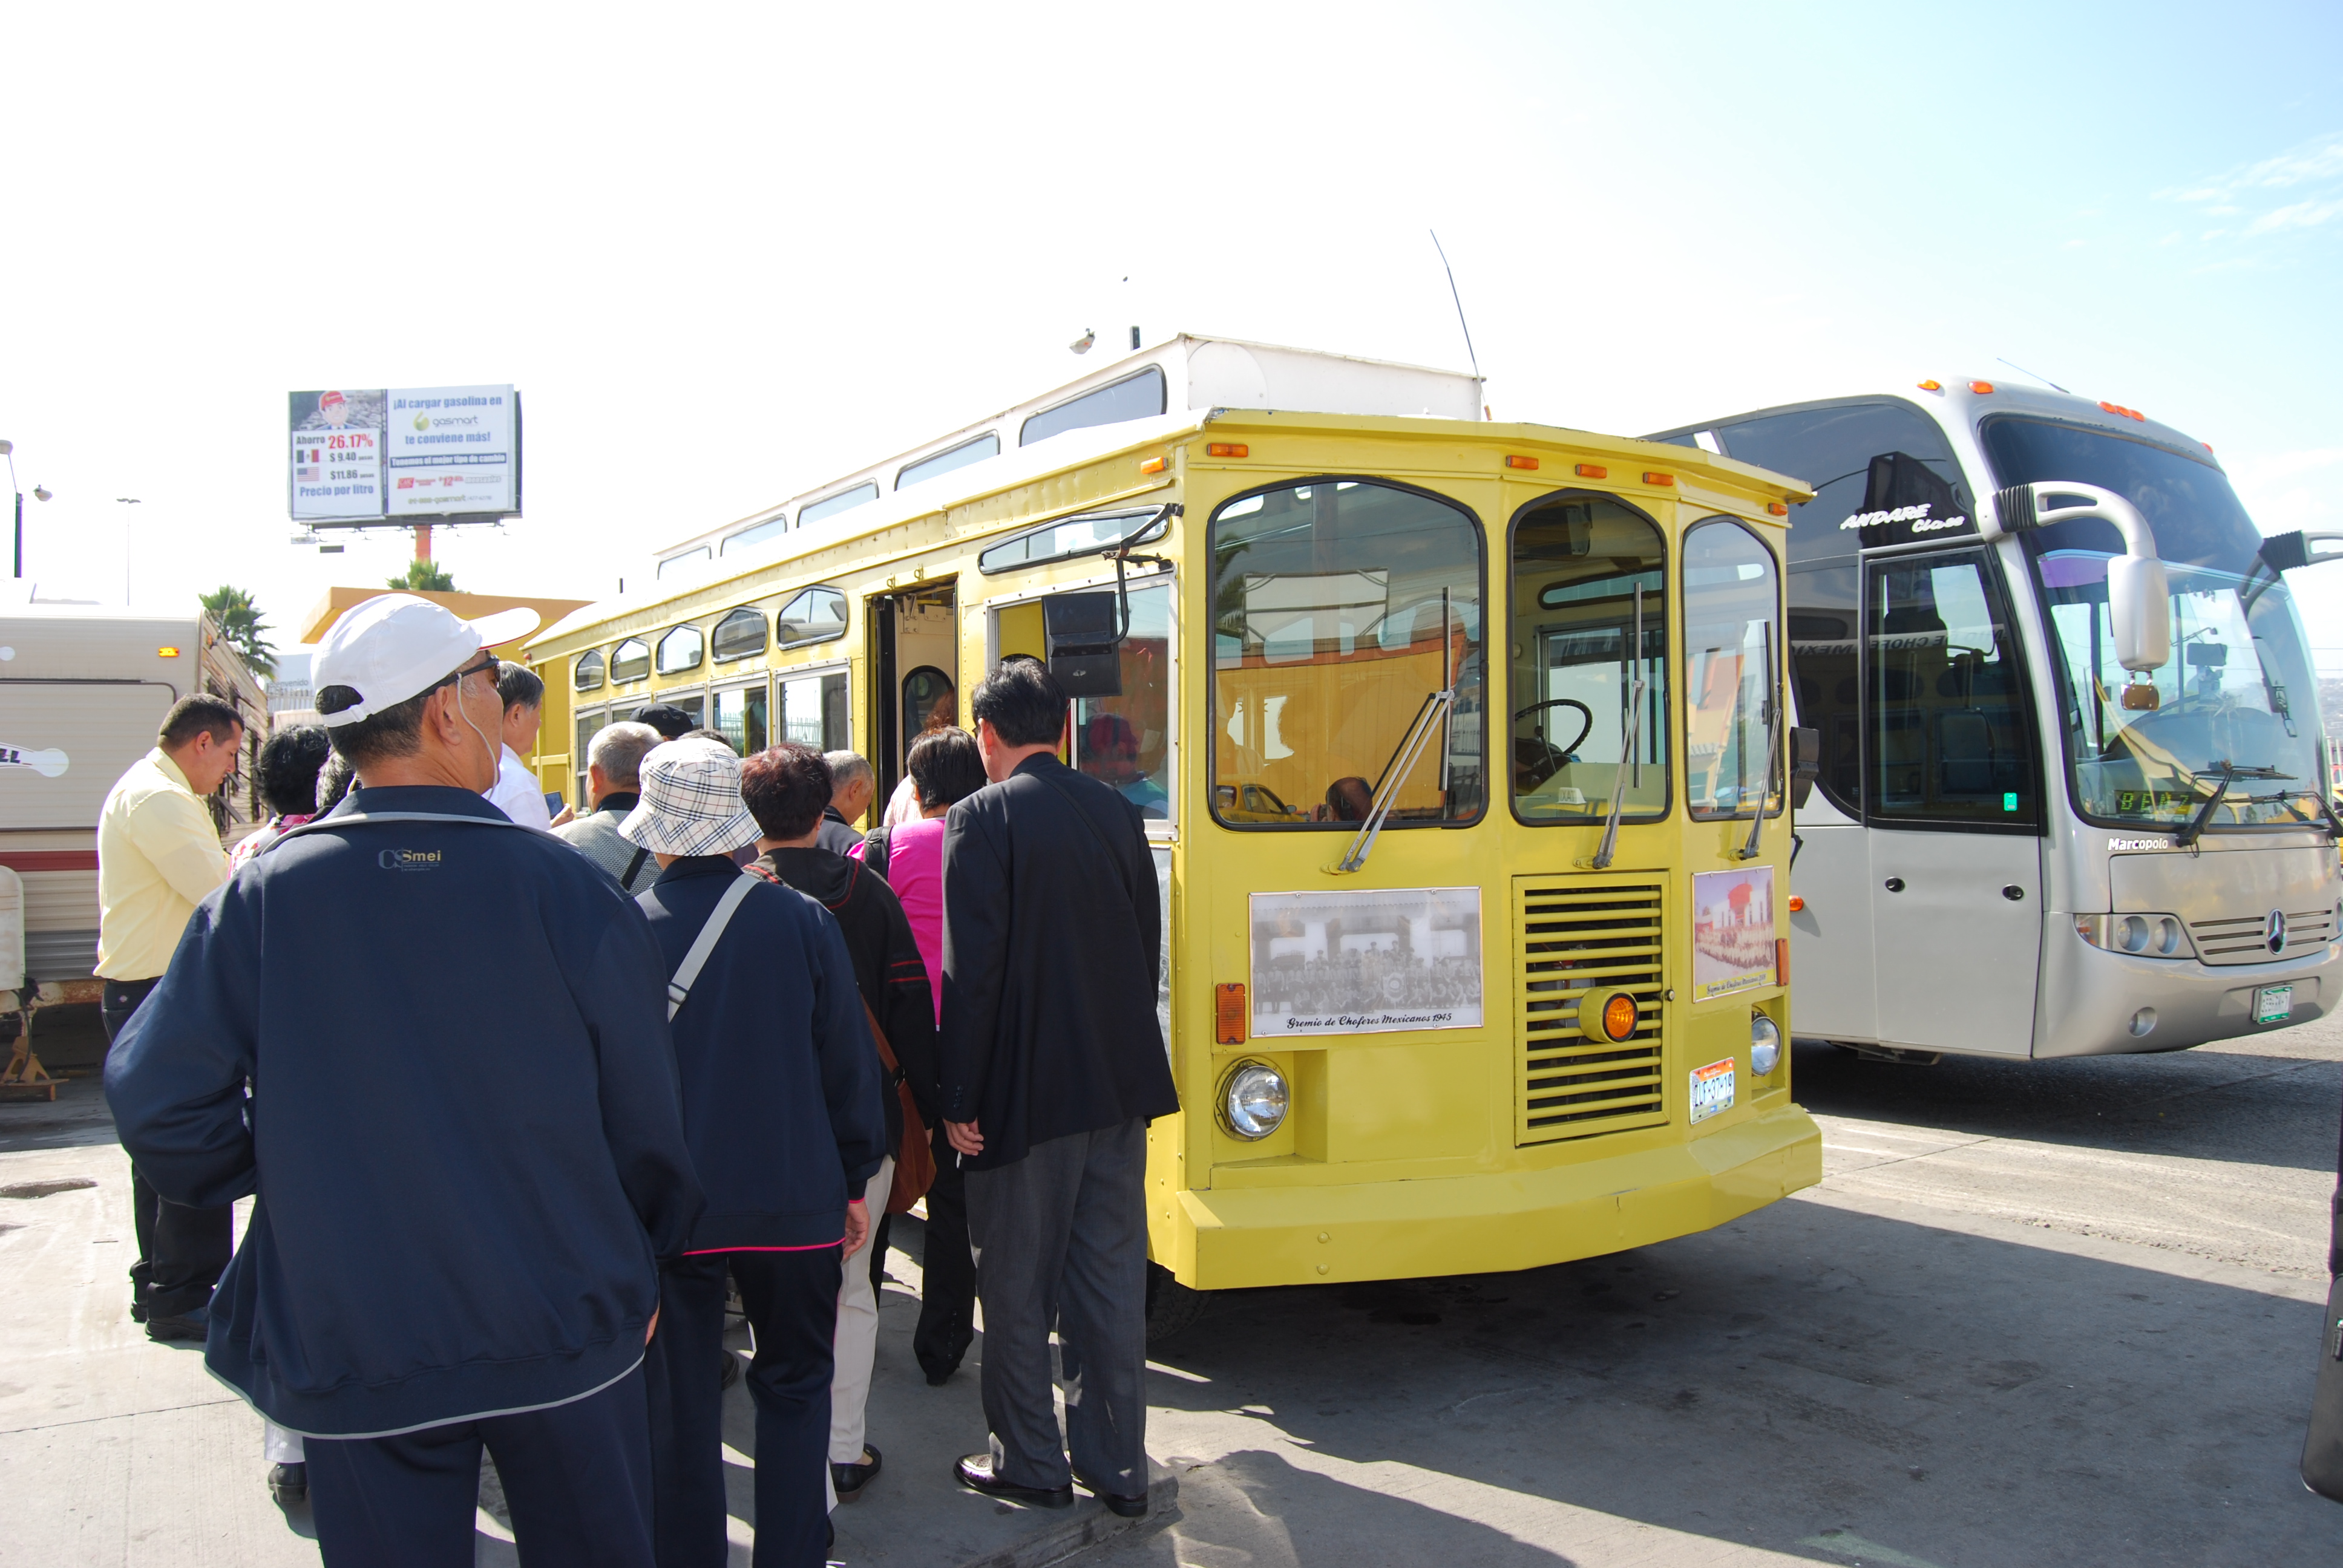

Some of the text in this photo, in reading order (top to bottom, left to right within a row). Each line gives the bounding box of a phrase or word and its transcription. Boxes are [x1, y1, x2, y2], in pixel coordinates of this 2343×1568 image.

[408, 399, 441, 409] cargar
[444, 396, 487, 408] gasolina
[490, 396, 502, 405] en
[433, 414, 478, 427] gasmart
[297, 433, 373, 449] Ahorro 26.17%
[405, 431, 491, 445] te conviene más!
[338, 452, 356, 461] 9.40
[392, 457, 423, 466] Tenemos
[432, 456, 453, 465] mejor
[454, 454, 468, 463] tipo
[469, 454, 478, 463] de
[479, 454, 505, 463] cambio
[330, 469, 358, 480] $11.86
[300, 484, 373, 497] Precio por litro
[1840, 503, 1932, 530] ANDARE
[1912, 515, 1965, 533] Class
[2120, 792, 2189, 812] BENZ
[2108, 837, 2168, 851] Marcopolo
[1286, 1013, 1452, 1029] Gremio de Choferes Mexicanos 1945
